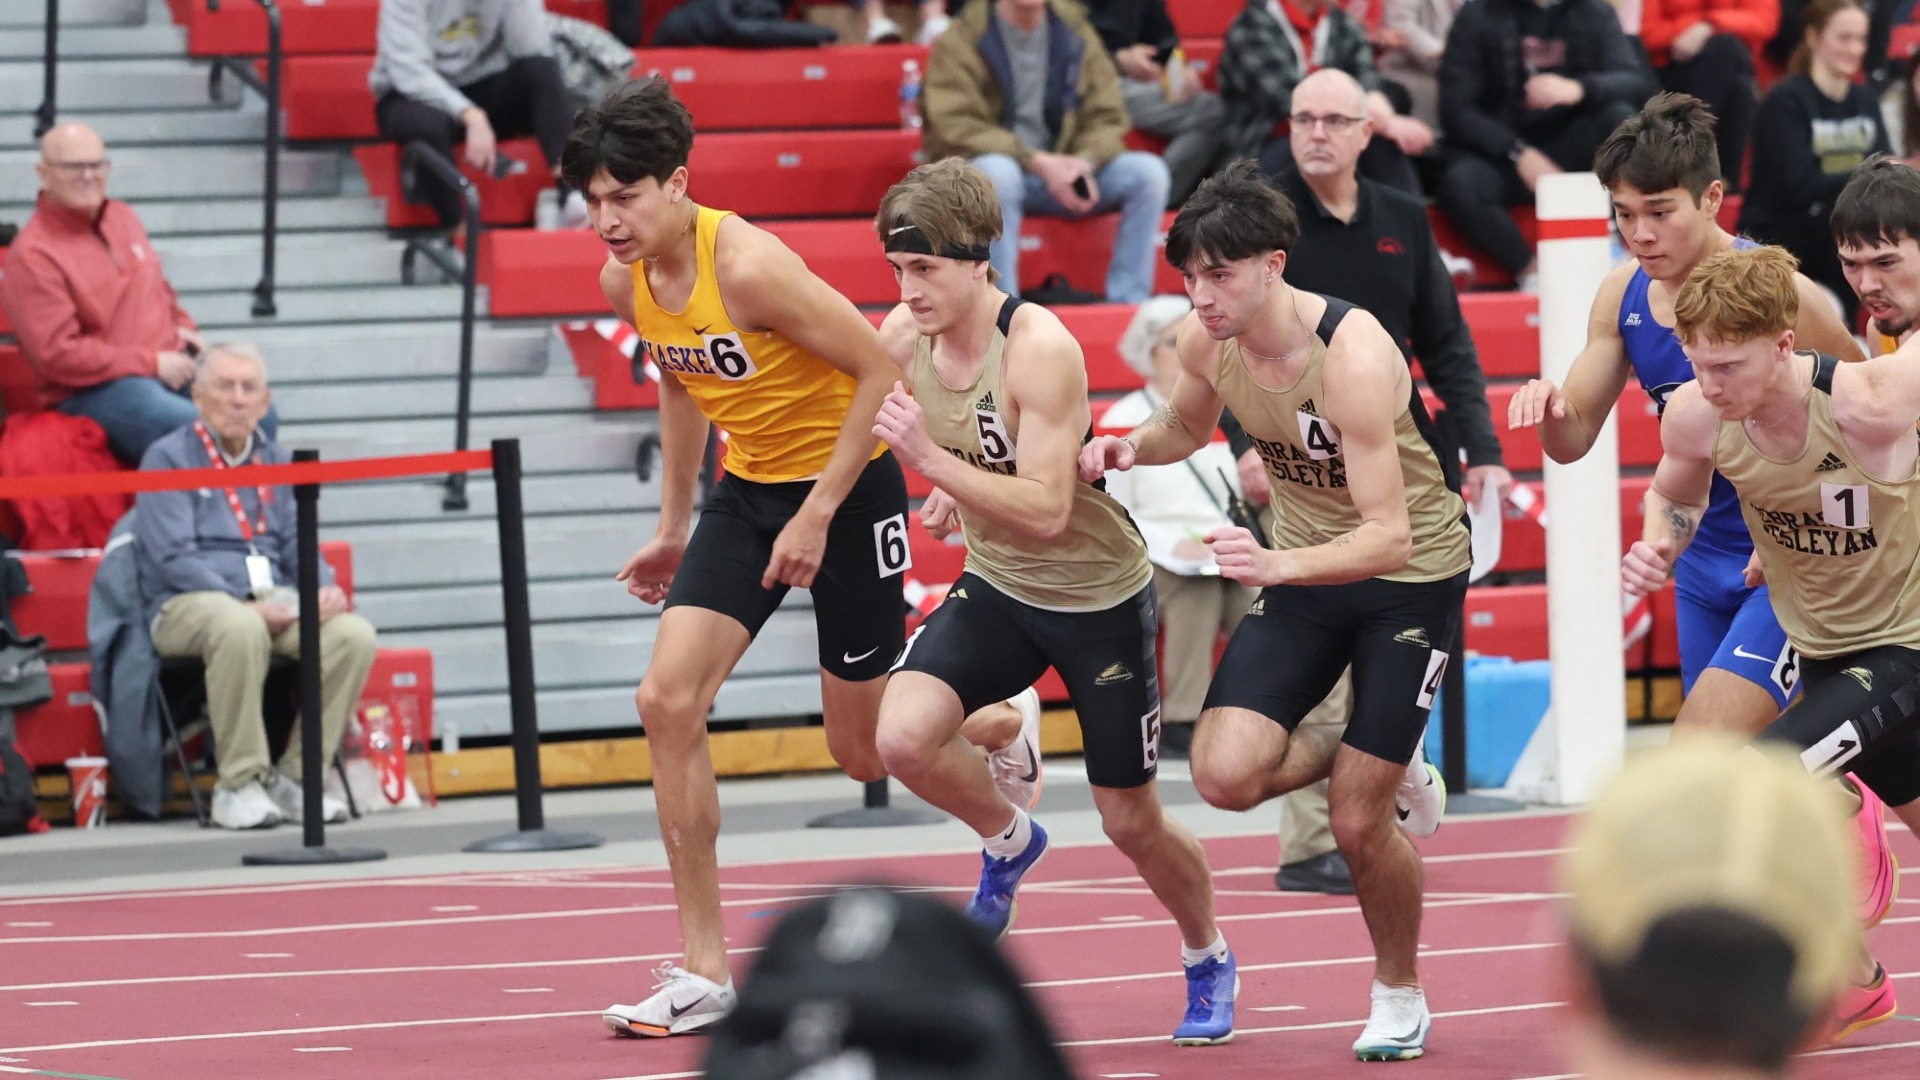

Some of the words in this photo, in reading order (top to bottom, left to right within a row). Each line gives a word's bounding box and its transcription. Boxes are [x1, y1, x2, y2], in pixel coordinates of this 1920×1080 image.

[710, 338, 747, 377] 6
[976, 403, 996, 412] adidas
[977, 413, 1008, 459] 5
[1307, 419, 1338, 455] 4
[1834, 488, 1855, 526] 1
[880, 520, 906, 570] 6
[1424, 657, 1447, 706] 4
[1146, 709, 1160, 762] 5
[1812, 739, 1858, 772] 1
